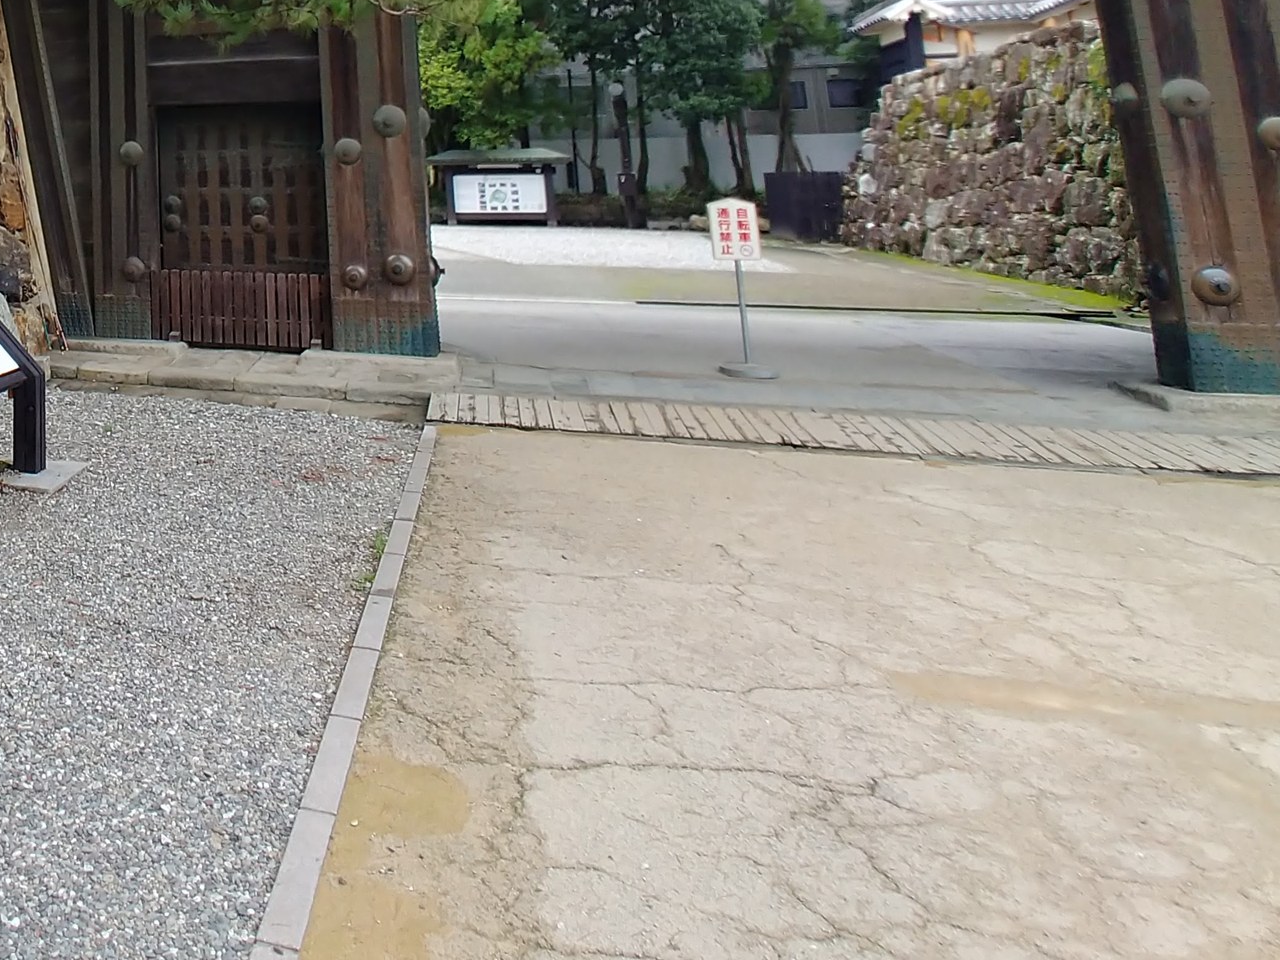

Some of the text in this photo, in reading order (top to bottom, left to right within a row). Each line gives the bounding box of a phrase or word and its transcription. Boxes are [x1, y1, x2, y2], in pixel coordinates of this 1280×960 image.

[716, 207, 734, 255] 通行禁止
[736, 208, 752, 243] 自転車
